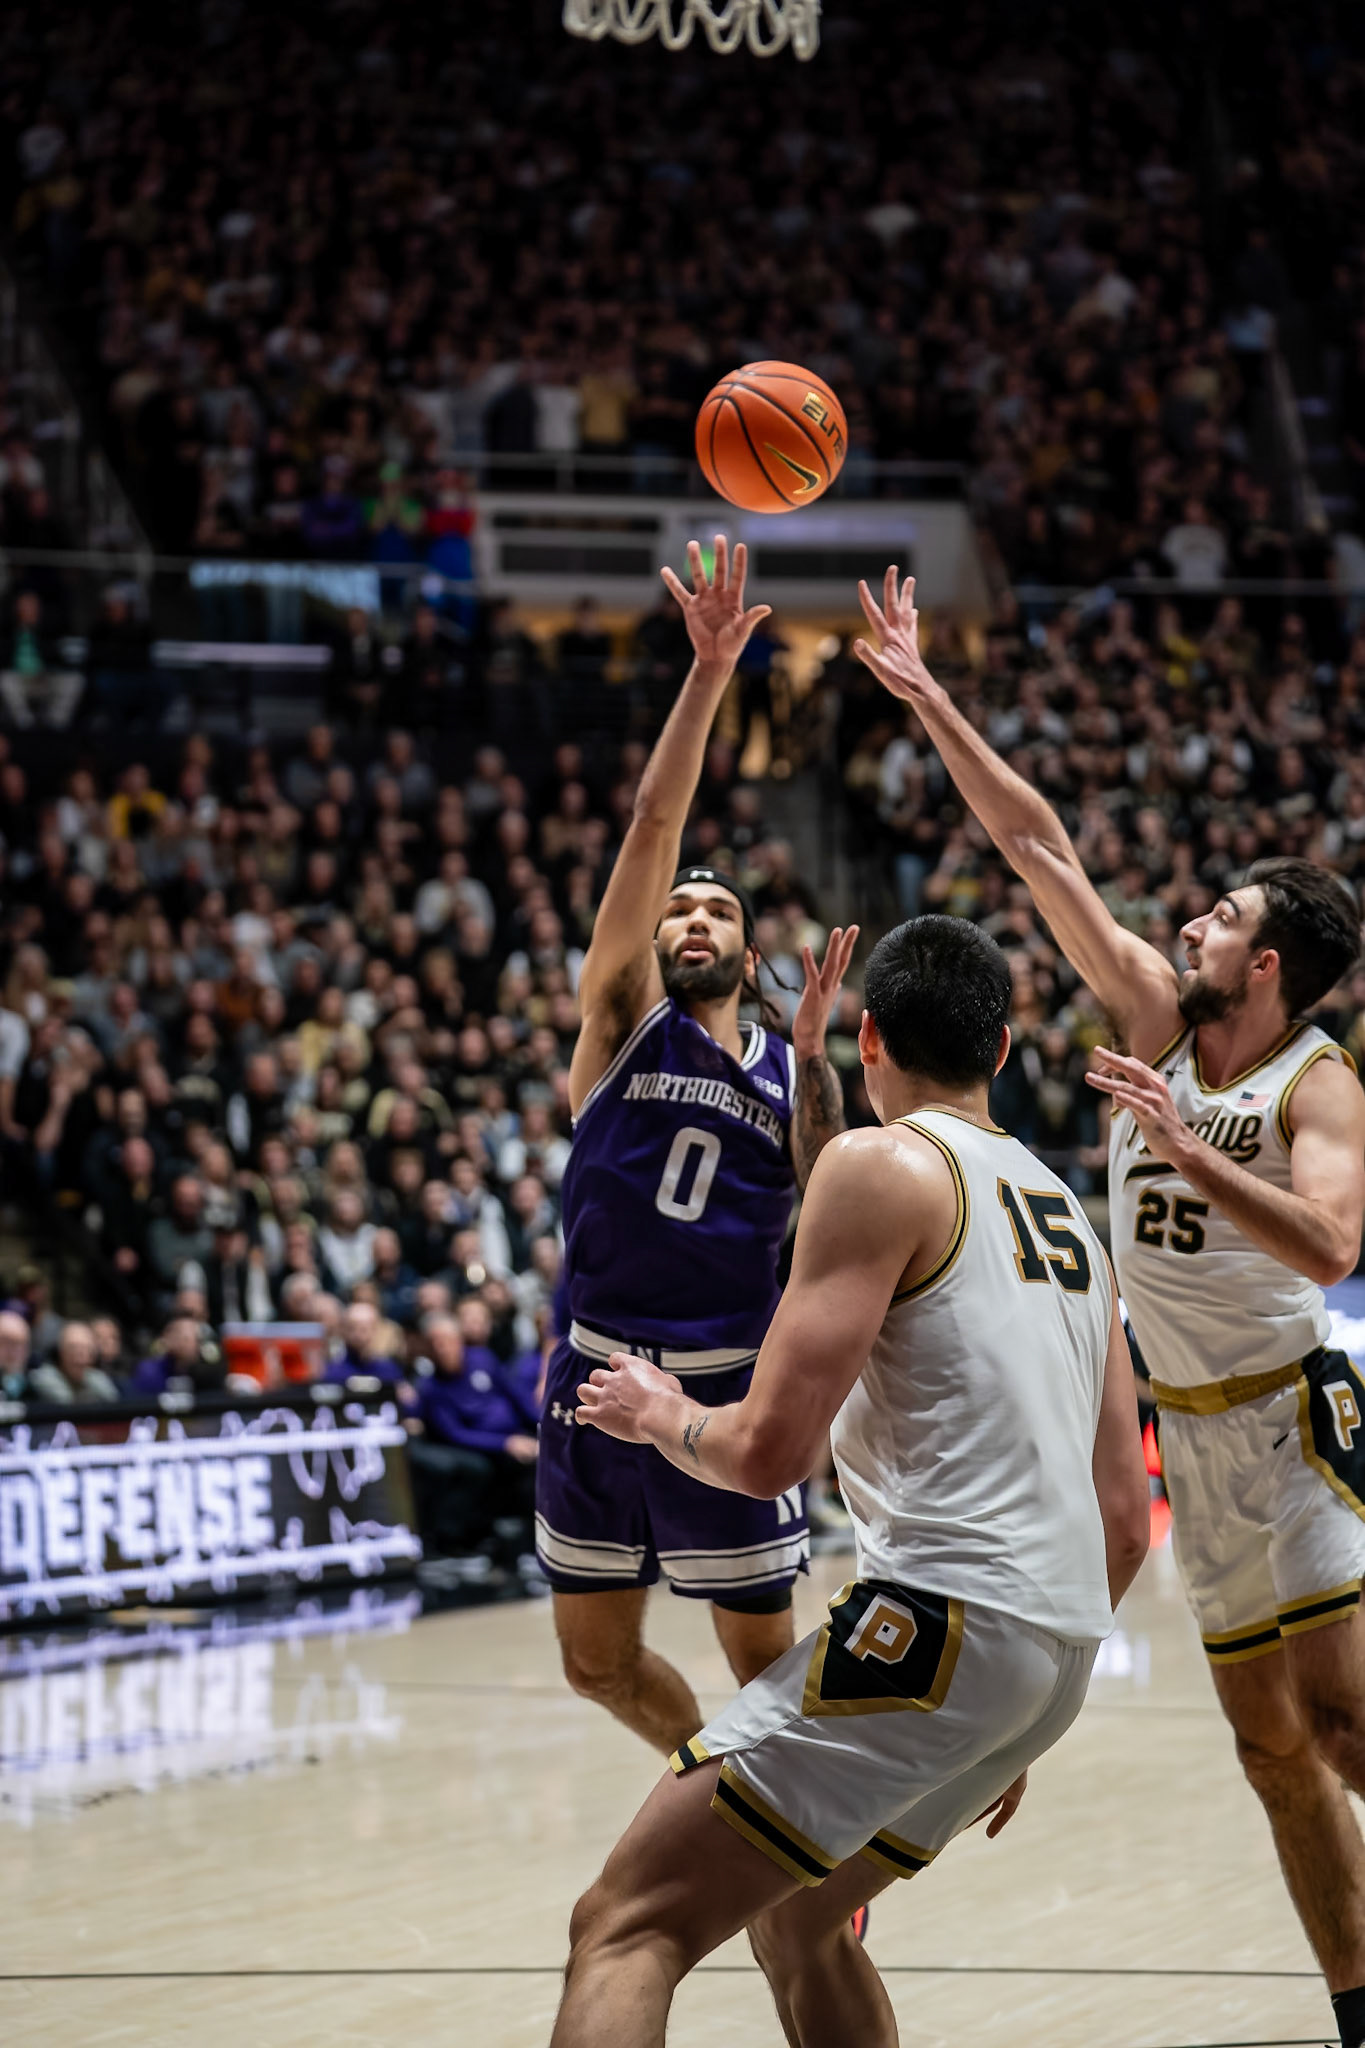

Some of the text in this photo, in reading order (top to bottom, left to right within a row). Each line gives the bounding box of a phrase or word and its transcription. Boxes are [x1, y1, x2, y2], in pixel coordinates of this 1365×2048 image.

[656, 1126, 722, 1222] 0
[997, 1176, 1092, 1295] 15
[1134, 1187, 1209, 1254] 25
[1322, 1380, 1362, 1451] P
[0, 1456, 275, 1576] DEFENSE
[843, 1592, 919, 1665] P
